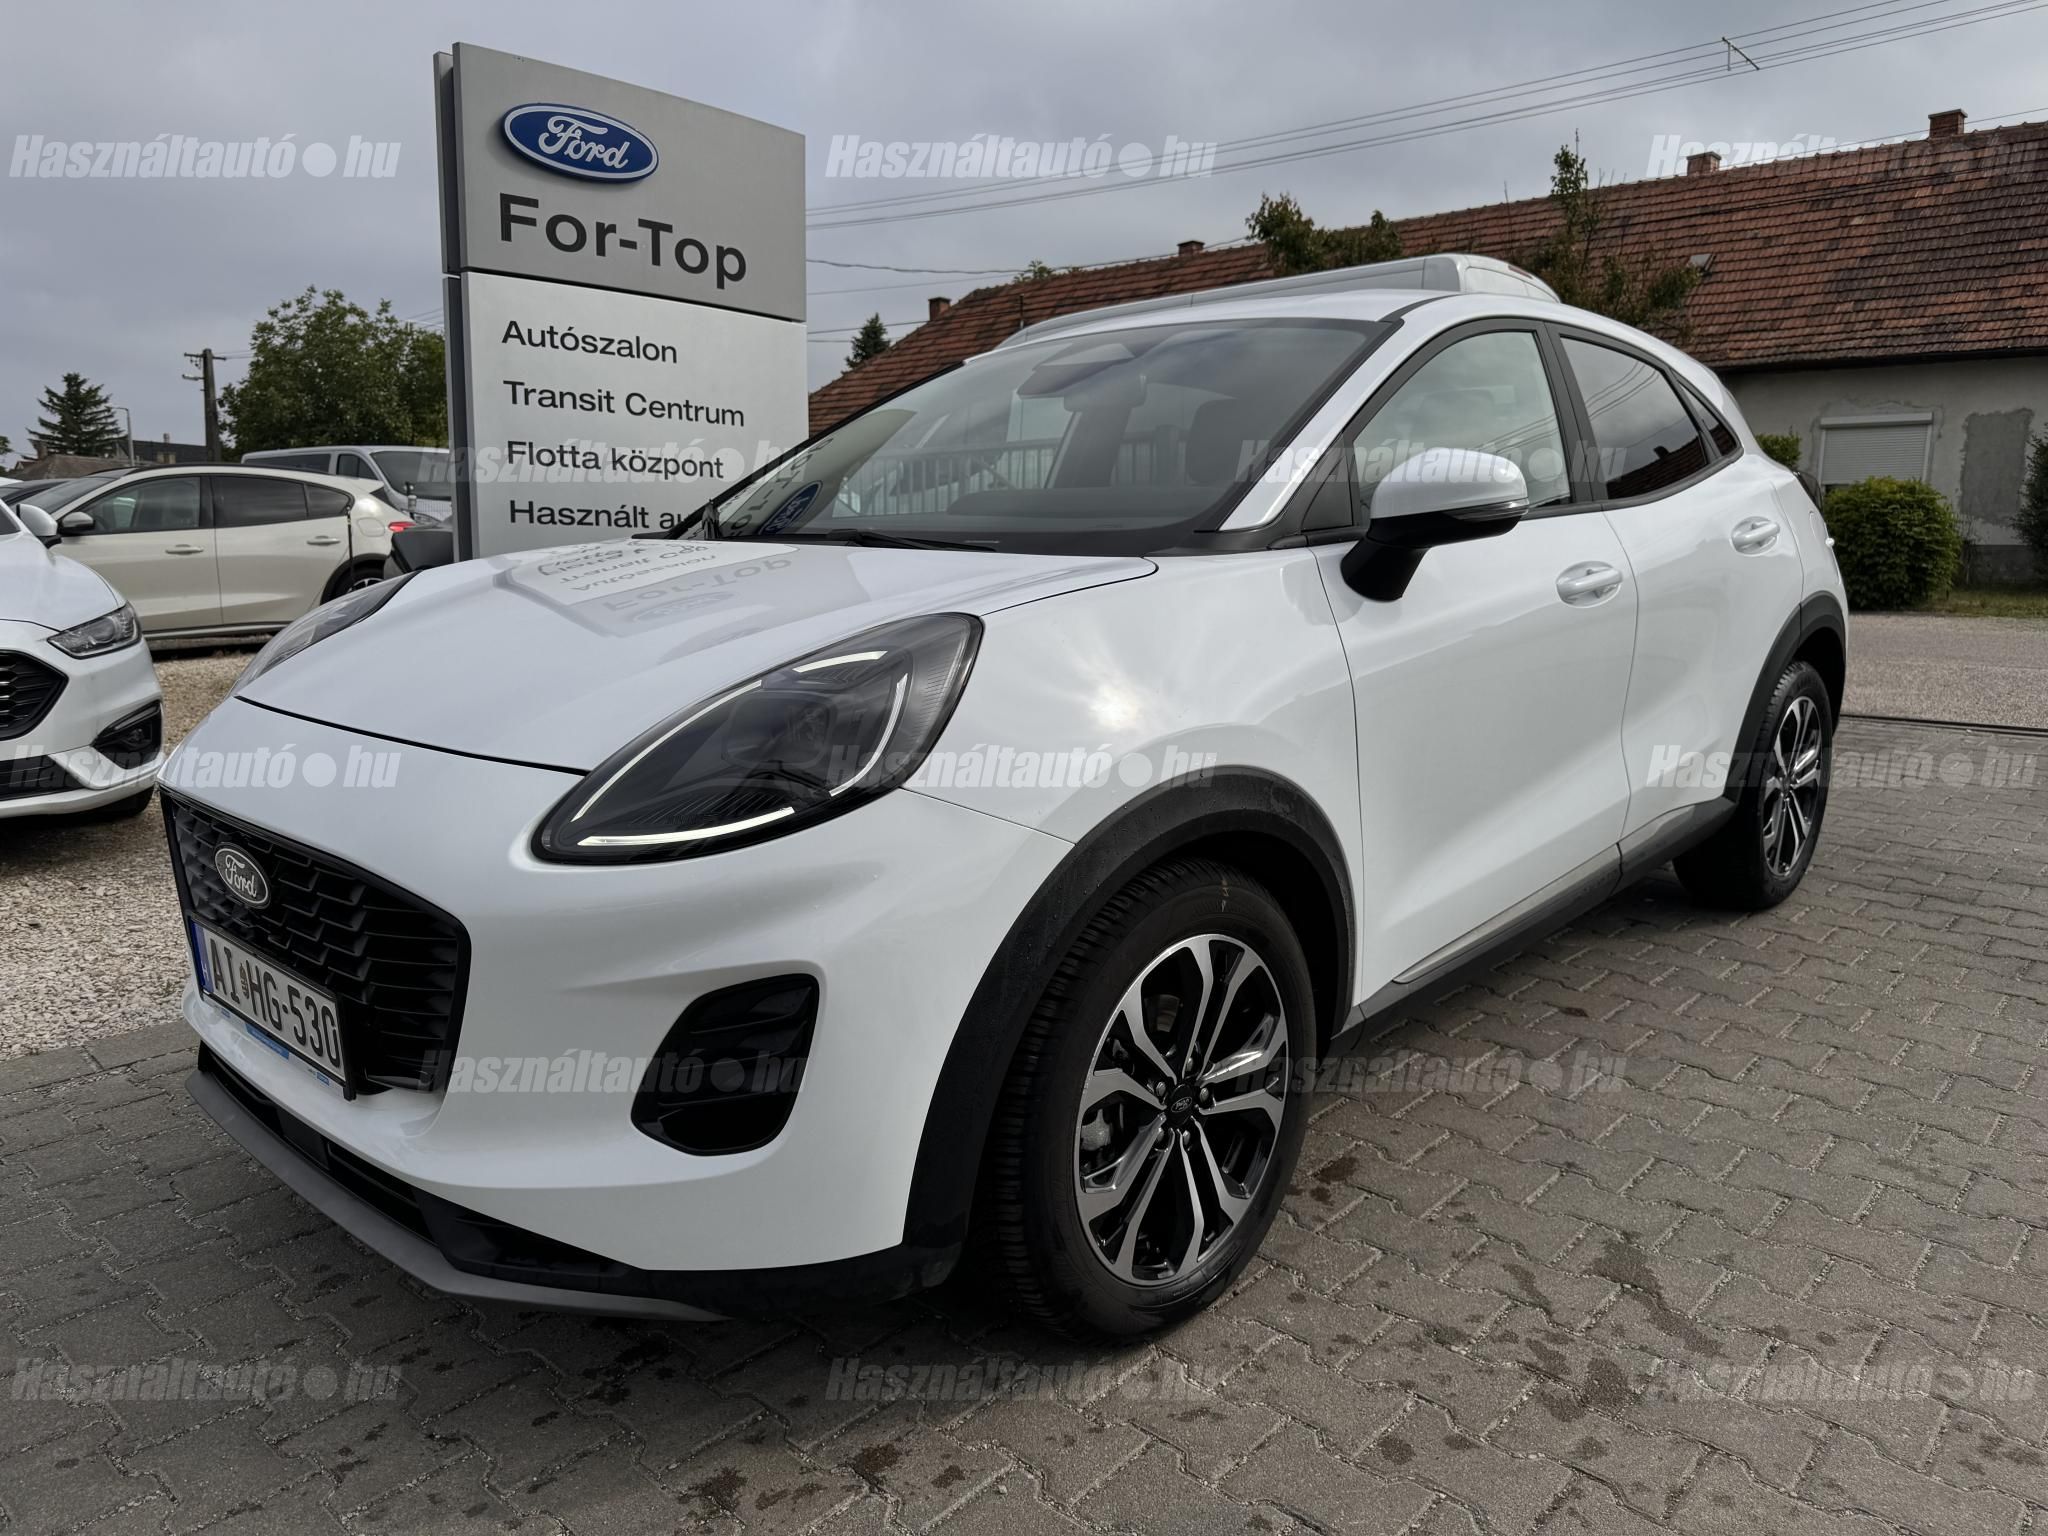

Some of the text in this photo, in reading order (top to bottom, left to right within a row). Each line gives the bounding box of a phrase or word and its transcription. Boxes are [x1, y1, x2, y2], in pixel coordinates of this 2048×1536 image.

[538, 115, 630, 169] Ford
[500, 192, 746, 290] For-Top
[501, 320, 678, 363] Autószalon
[503, 380, 744, 427] Transit Centrum
[507, 440, 724, 480] Flotta központ
[509, 499, 650, 529] Használt
[224, 854, 258, 898] Ford
